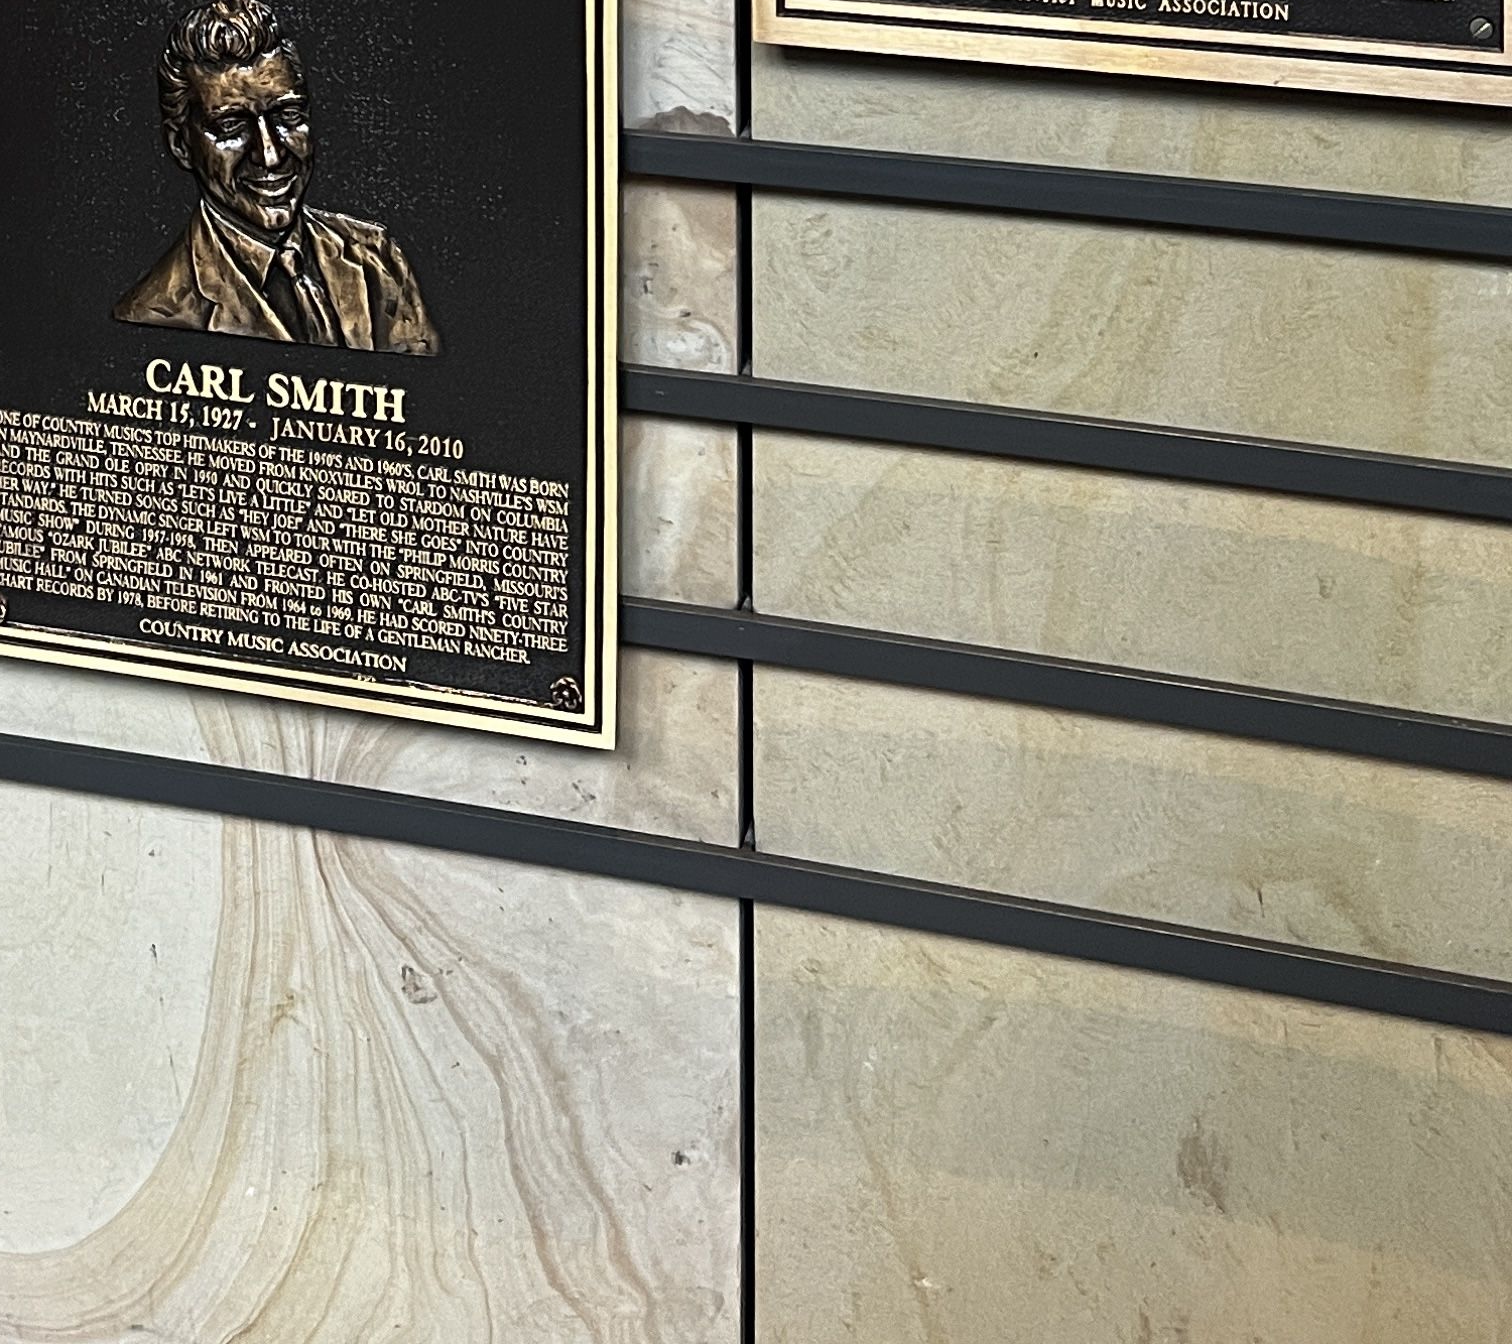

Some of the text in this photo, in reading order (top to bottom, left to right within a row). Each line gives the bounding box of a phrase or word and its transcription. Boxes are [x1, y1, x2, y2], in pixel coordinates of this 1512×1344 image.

[145, 358, 406, 423] CARL SMITH
[87, 391, 464, 460] MARCH 15, 1927 JANUARY 16, 2010
[138, 617, 408, 673] COUNTRY MUSIC ASSOCIATION
